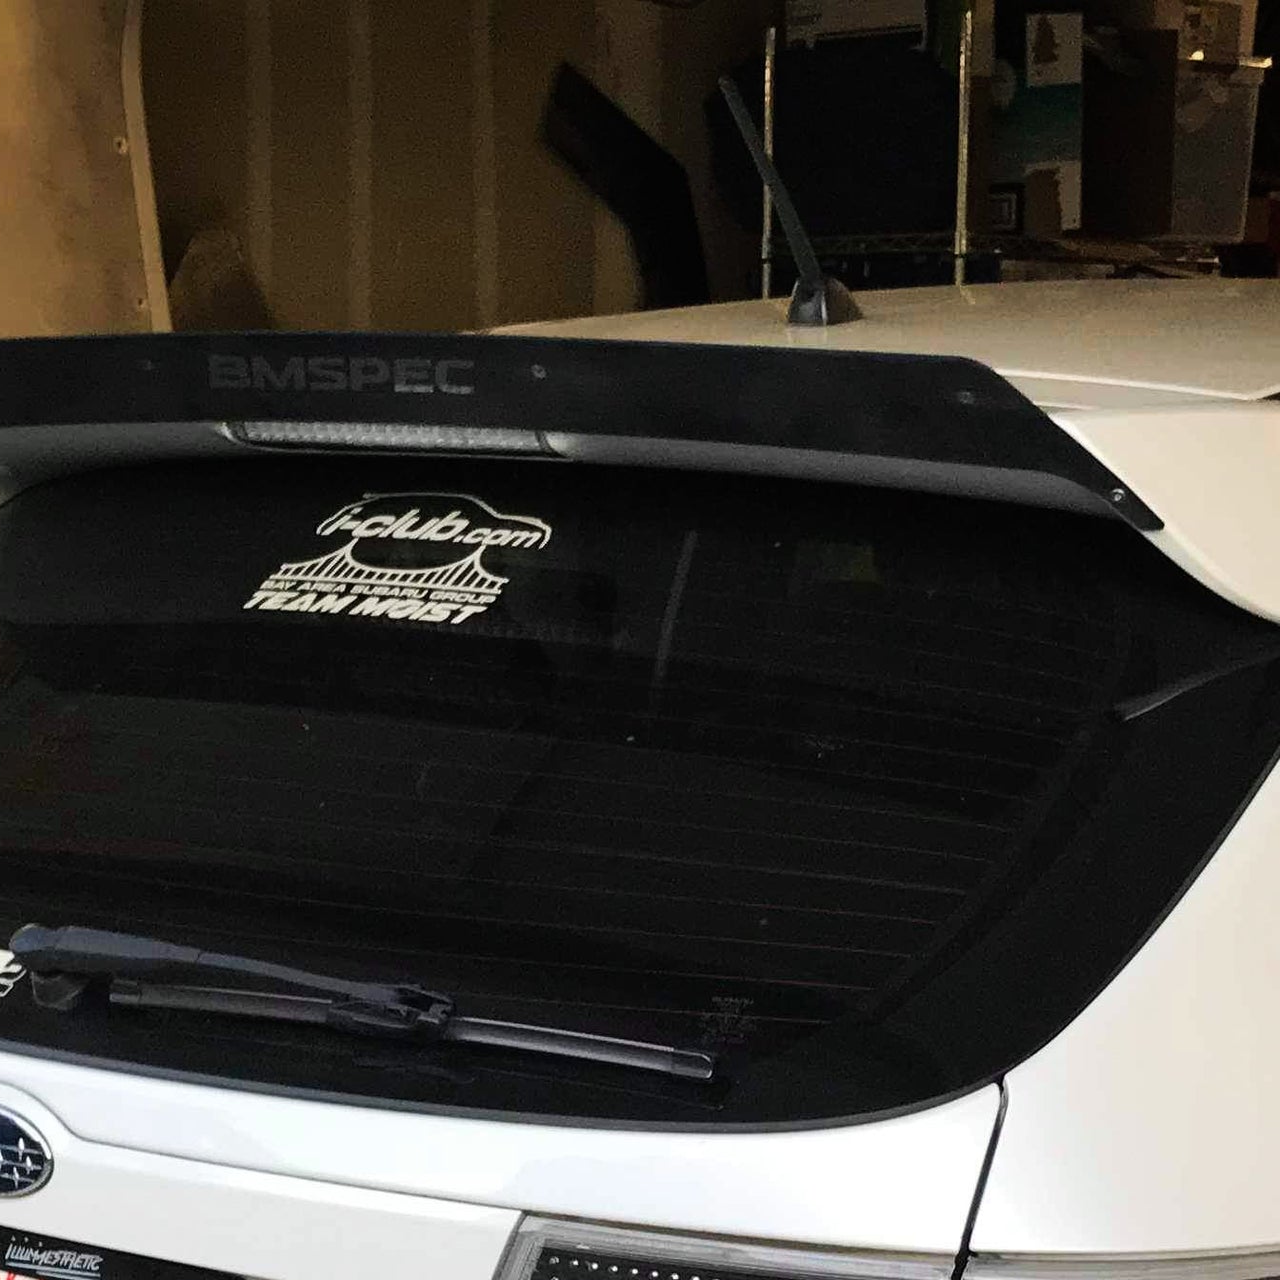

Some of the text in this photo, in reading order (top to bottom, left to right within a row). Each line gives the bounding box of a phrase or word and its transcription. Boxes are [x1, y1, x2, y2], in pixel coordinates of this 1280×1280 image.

[208, 355, 474, 394] BMSPEC
[321, 507, 543, 549] i-club.com
[243, 591, 488, 625] TEAM MOIST
[259, 580, 496, 605] BAY AREA SUBARU GROUP
